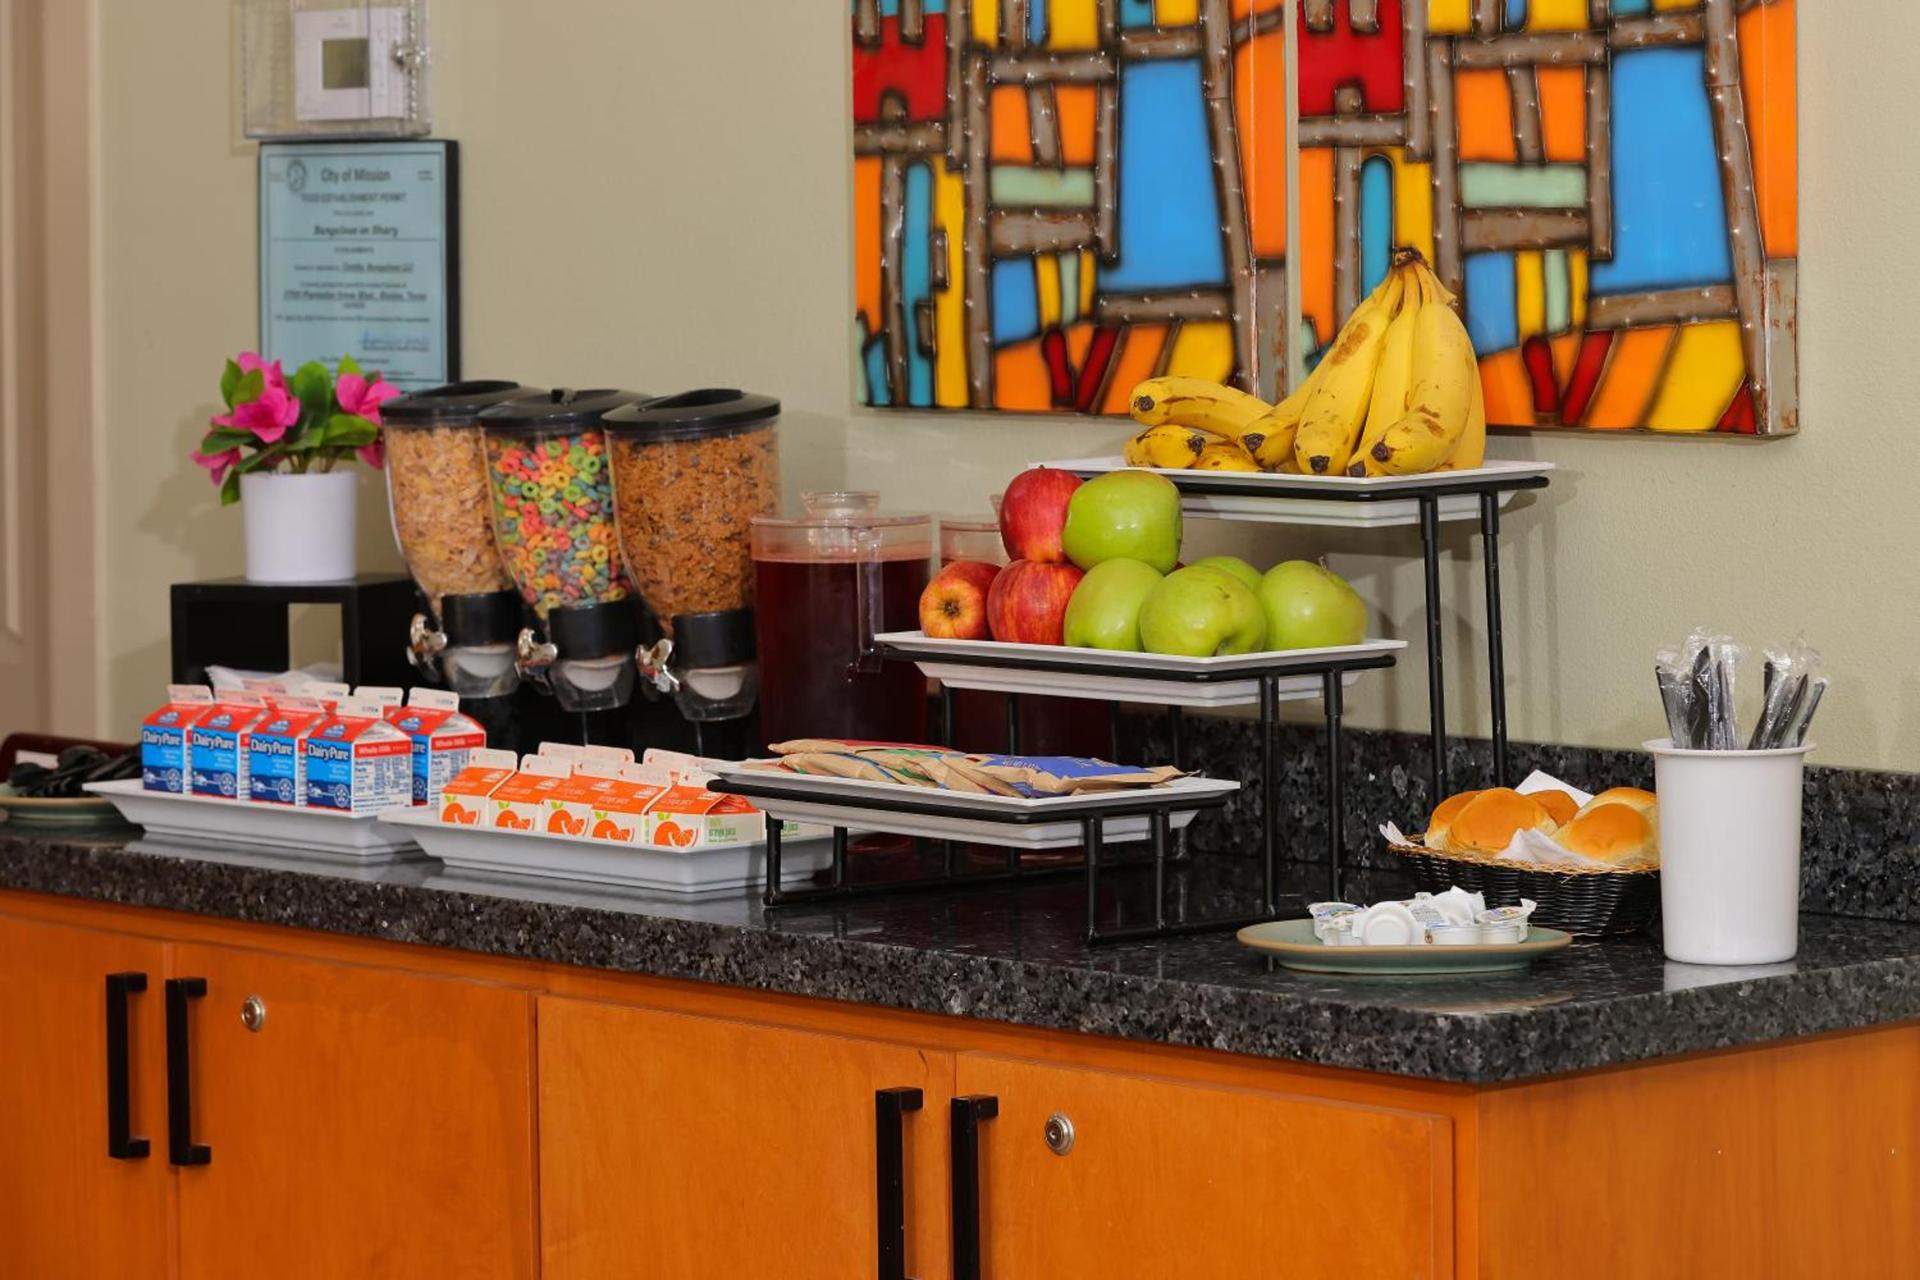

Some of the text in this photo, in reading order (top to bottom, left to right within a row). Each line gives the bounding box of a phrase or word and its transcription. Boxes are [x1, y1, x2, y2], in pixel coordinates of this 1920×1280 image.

[143, 730, 182, 746] DairyPure
[192, 732, 235, 750] DairyPure
[251, 738, 293, 756] DairyPure
[308, 743, 349, 761] DairyPure
